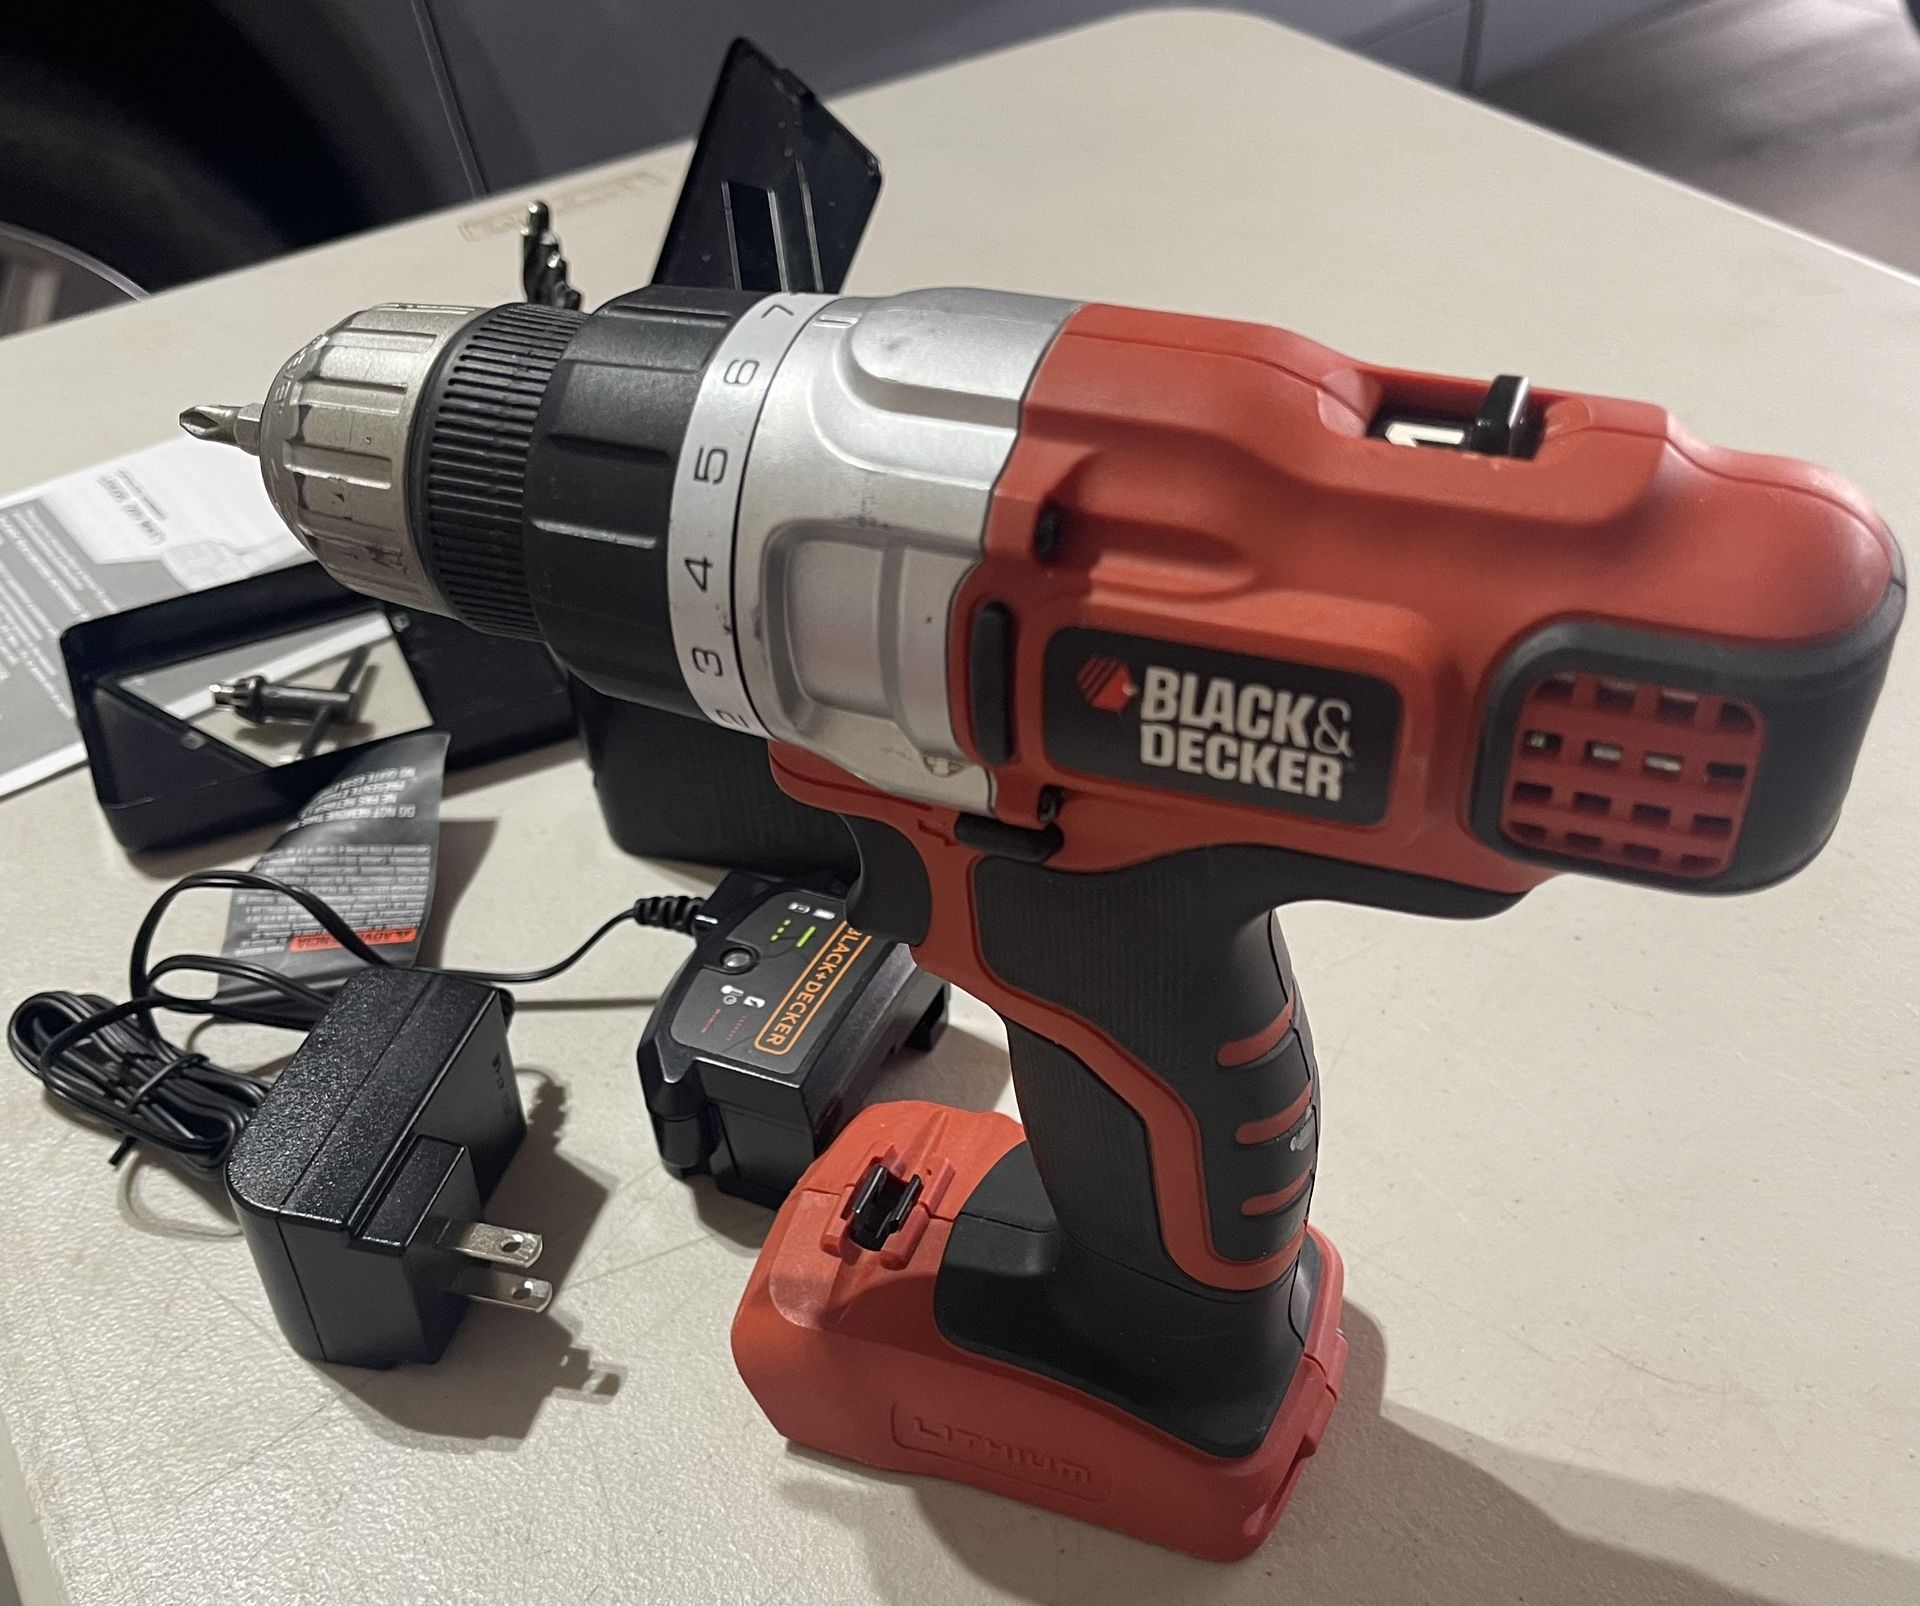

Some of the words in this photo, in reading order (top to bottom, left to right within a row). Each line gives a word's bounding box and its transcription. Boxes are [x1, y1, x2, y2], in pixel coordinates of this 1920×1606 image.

[760, 303, 795, 320] 7
[723, 358, 761, 386] 6
[693, 447, 729, 485] 5
[684, 555, 714, 594] 4
[691, 645, 725, 678] 3
[1139, 721, 1344, 802] DECKER
